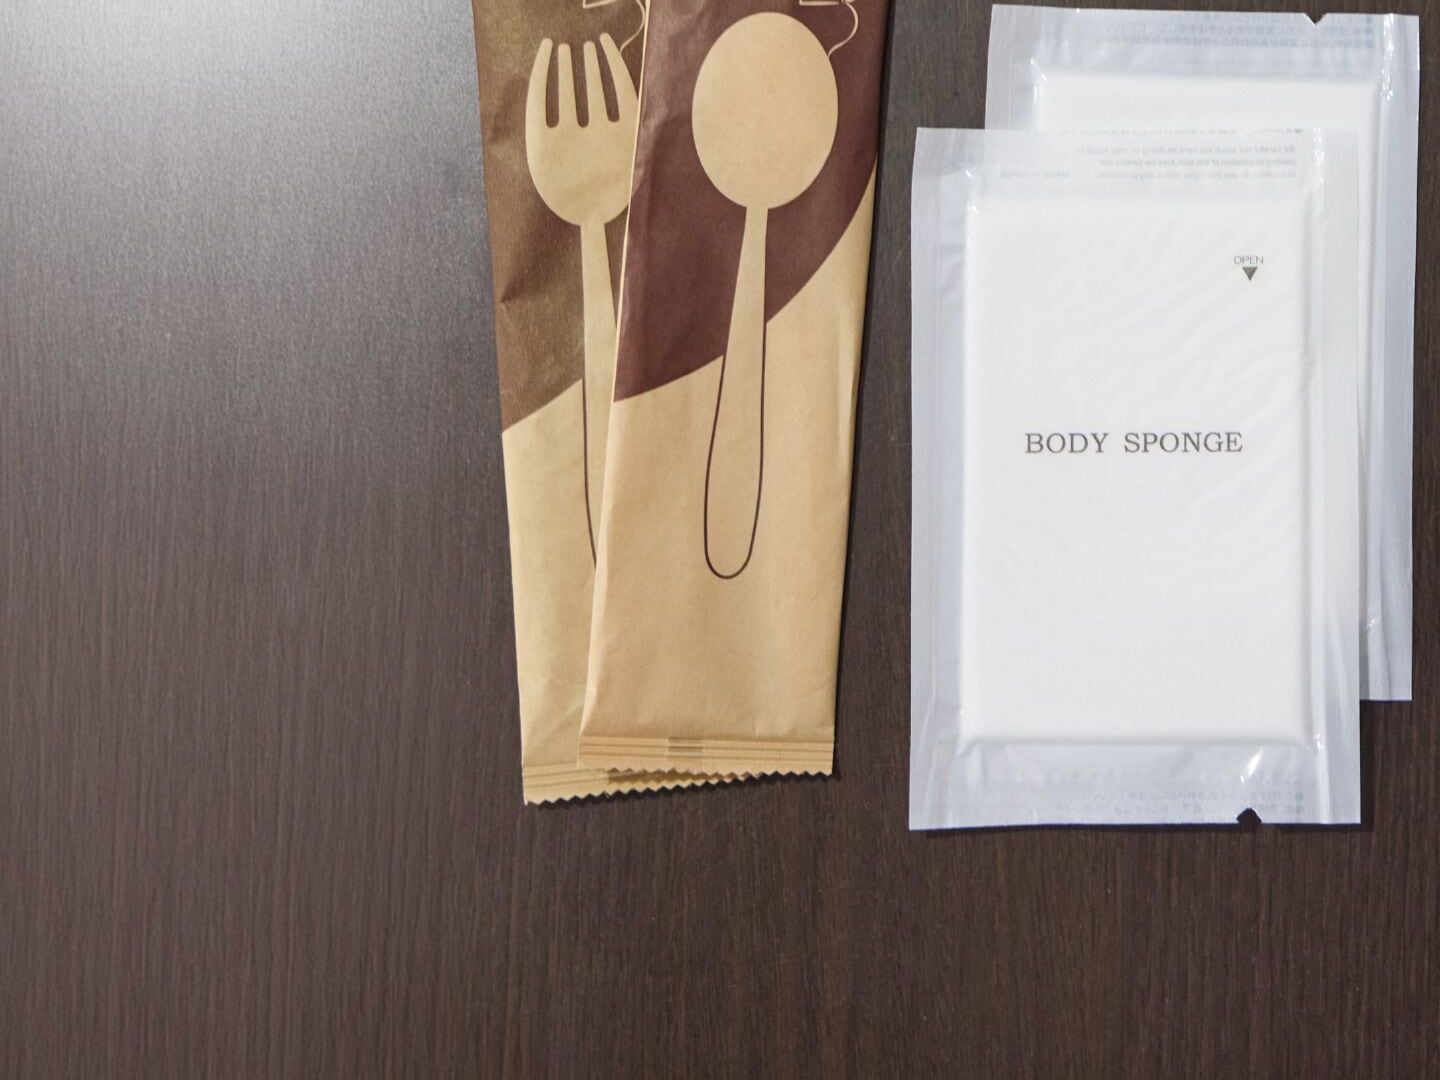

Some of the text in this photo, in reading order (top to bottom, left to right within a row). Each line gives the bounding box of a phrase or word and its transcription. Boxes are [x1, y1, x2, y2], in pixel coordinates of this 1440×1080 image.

[1233, 255, 1264, 265] OPEN
[1025, 431, 1244, 455] BODY SPONGE
